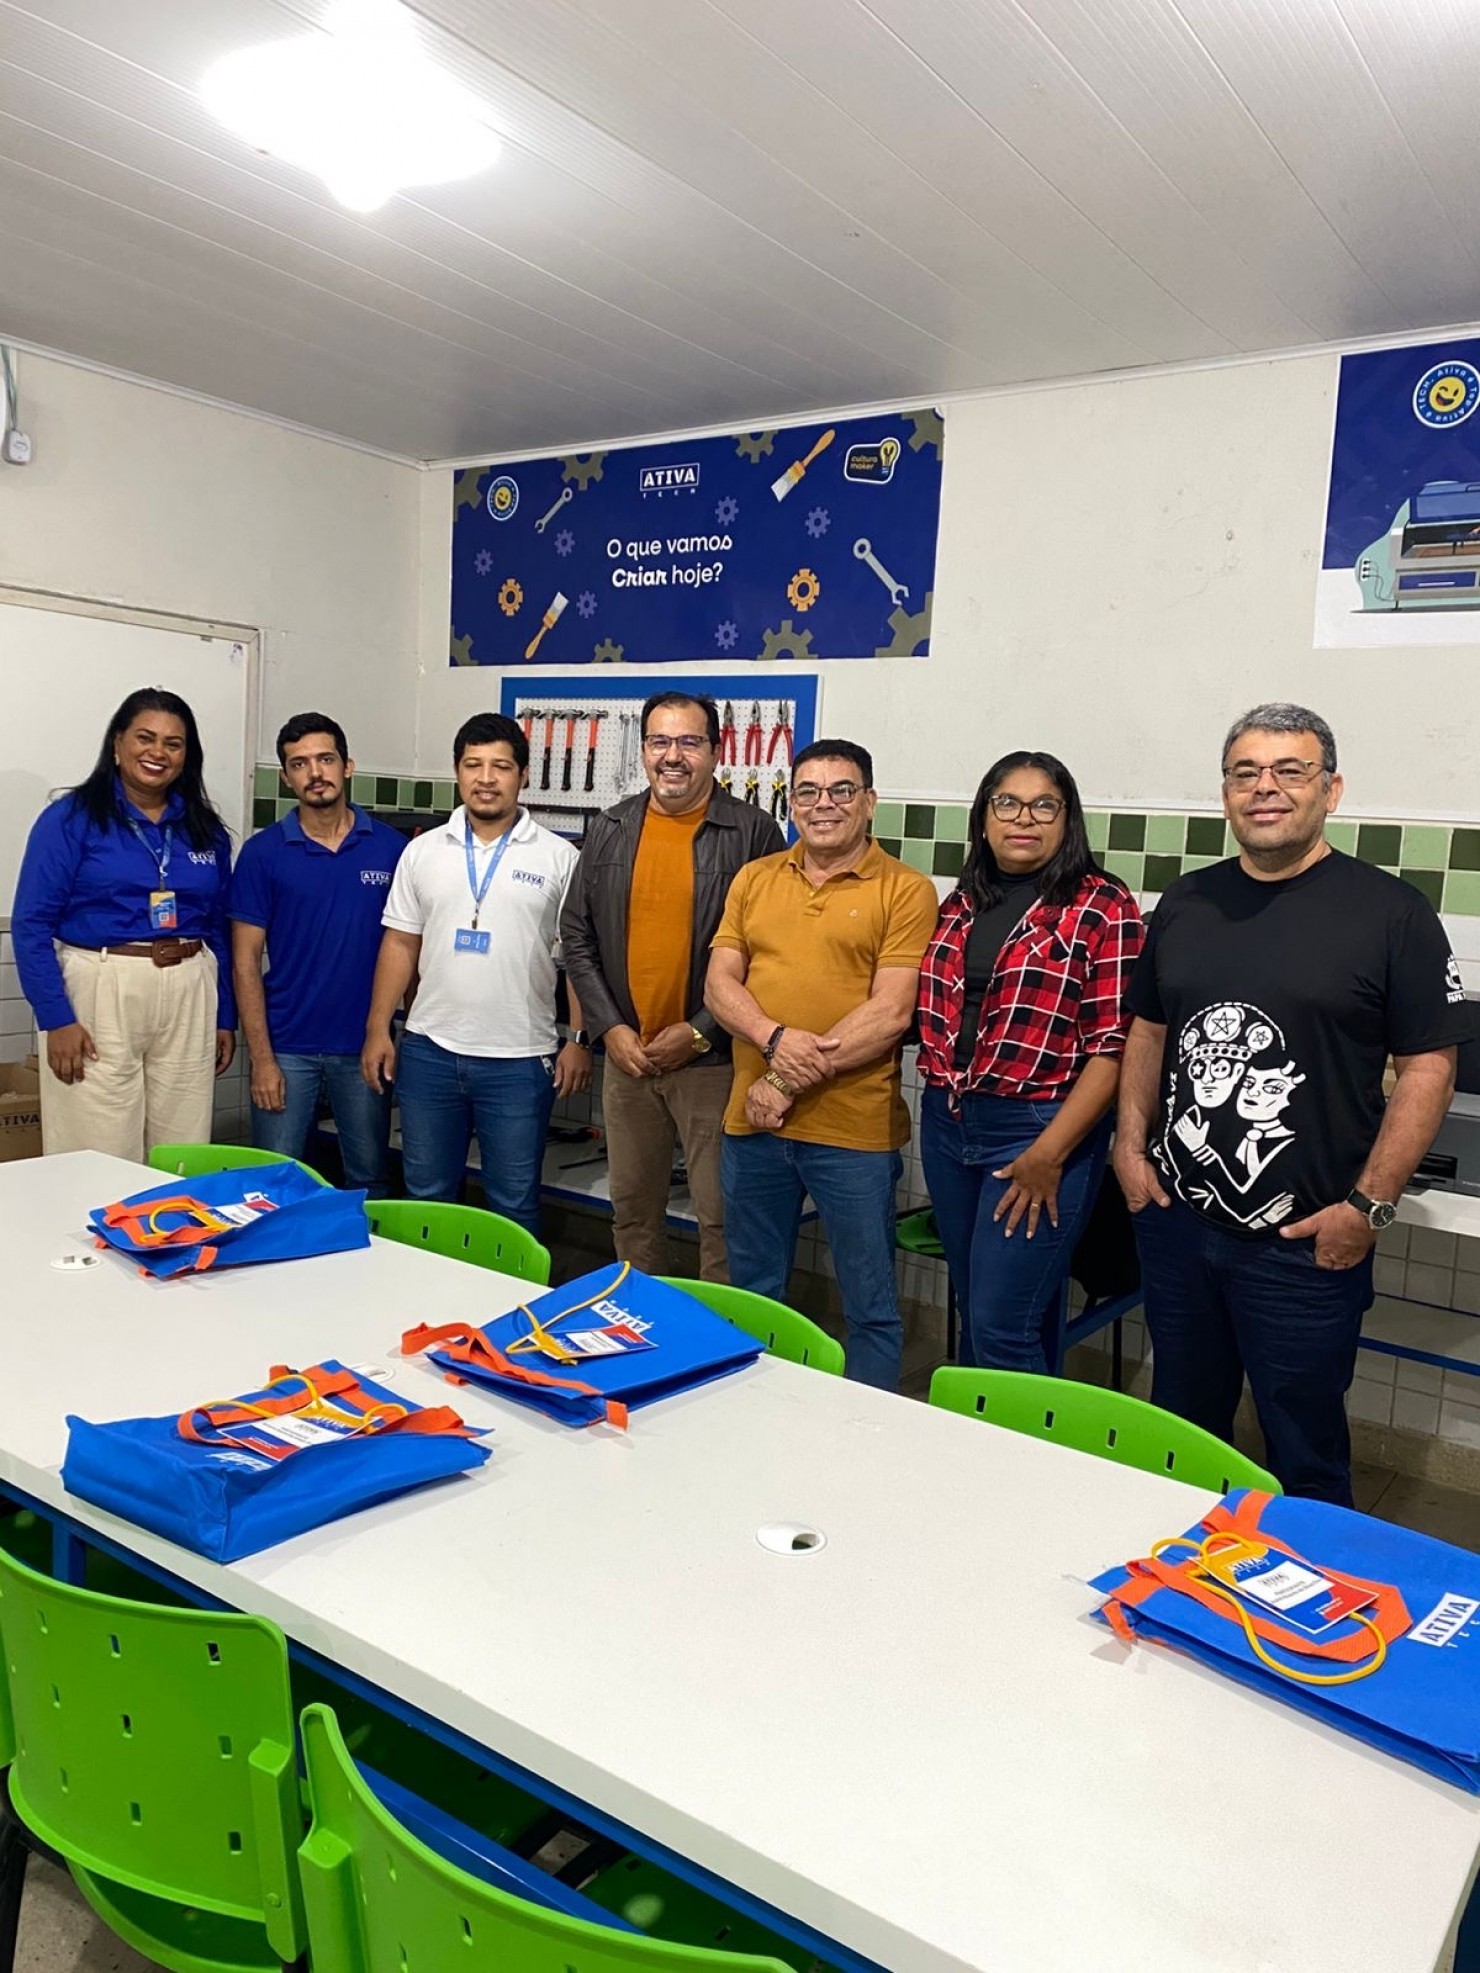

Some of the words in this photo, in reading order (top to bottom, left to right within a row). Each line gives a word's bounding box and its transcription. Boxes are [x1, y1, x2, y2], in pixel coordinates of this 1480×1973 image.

[643, 468, 696, 487] ATIVA
[607, 539, 621, 558] O
[626, 540, 661, 561] que
[666, 535, 733, 554] vamos
[612, 565, 667, 587] Criar
[671, 562, 723, 588] hoje?
[0, 1114, 40, 1126] TIVA
[1420, 1602, 1472, 1642] ATIVA
